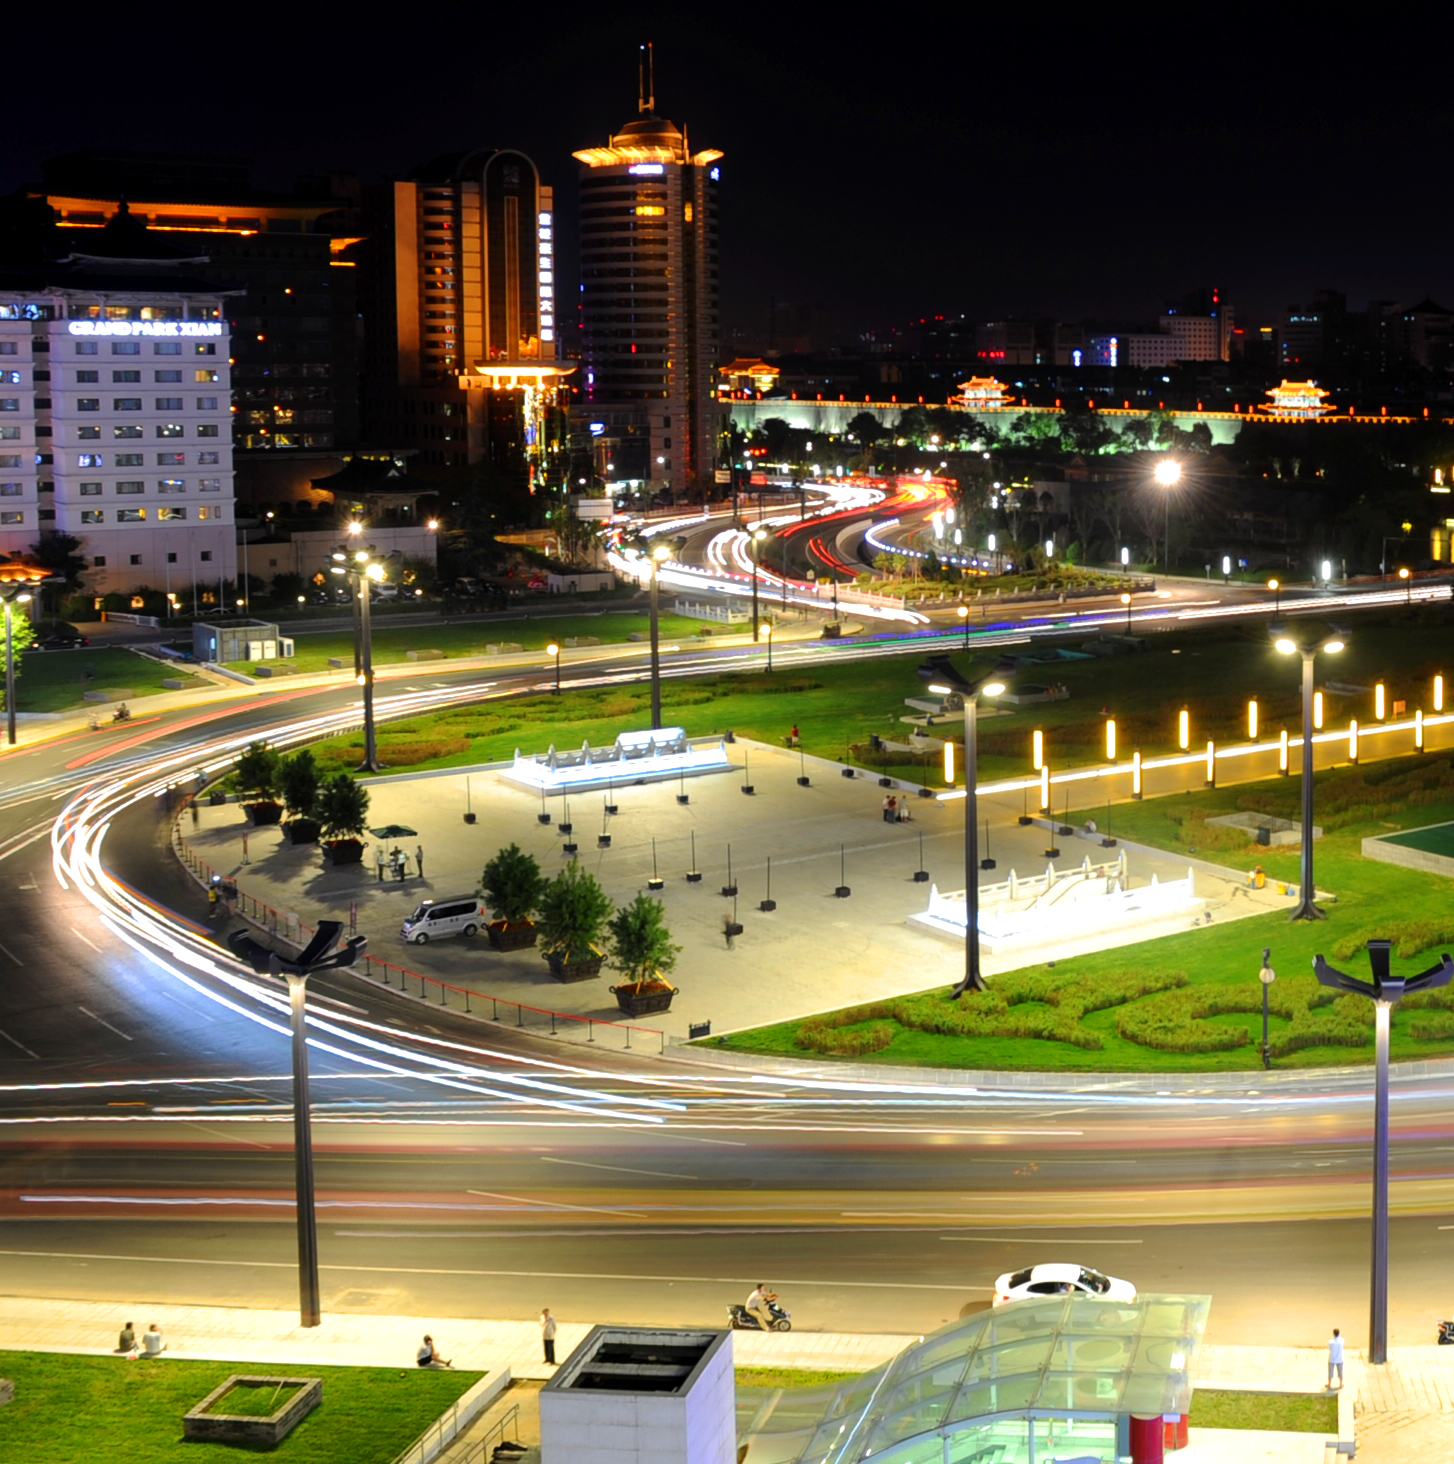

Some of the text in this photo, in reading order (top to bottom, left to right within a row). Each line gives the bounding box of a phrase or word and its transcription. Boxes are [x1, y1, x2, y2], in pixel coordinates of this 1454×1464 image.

[68, 320, 222, 337] GRAND PARK XIAN
